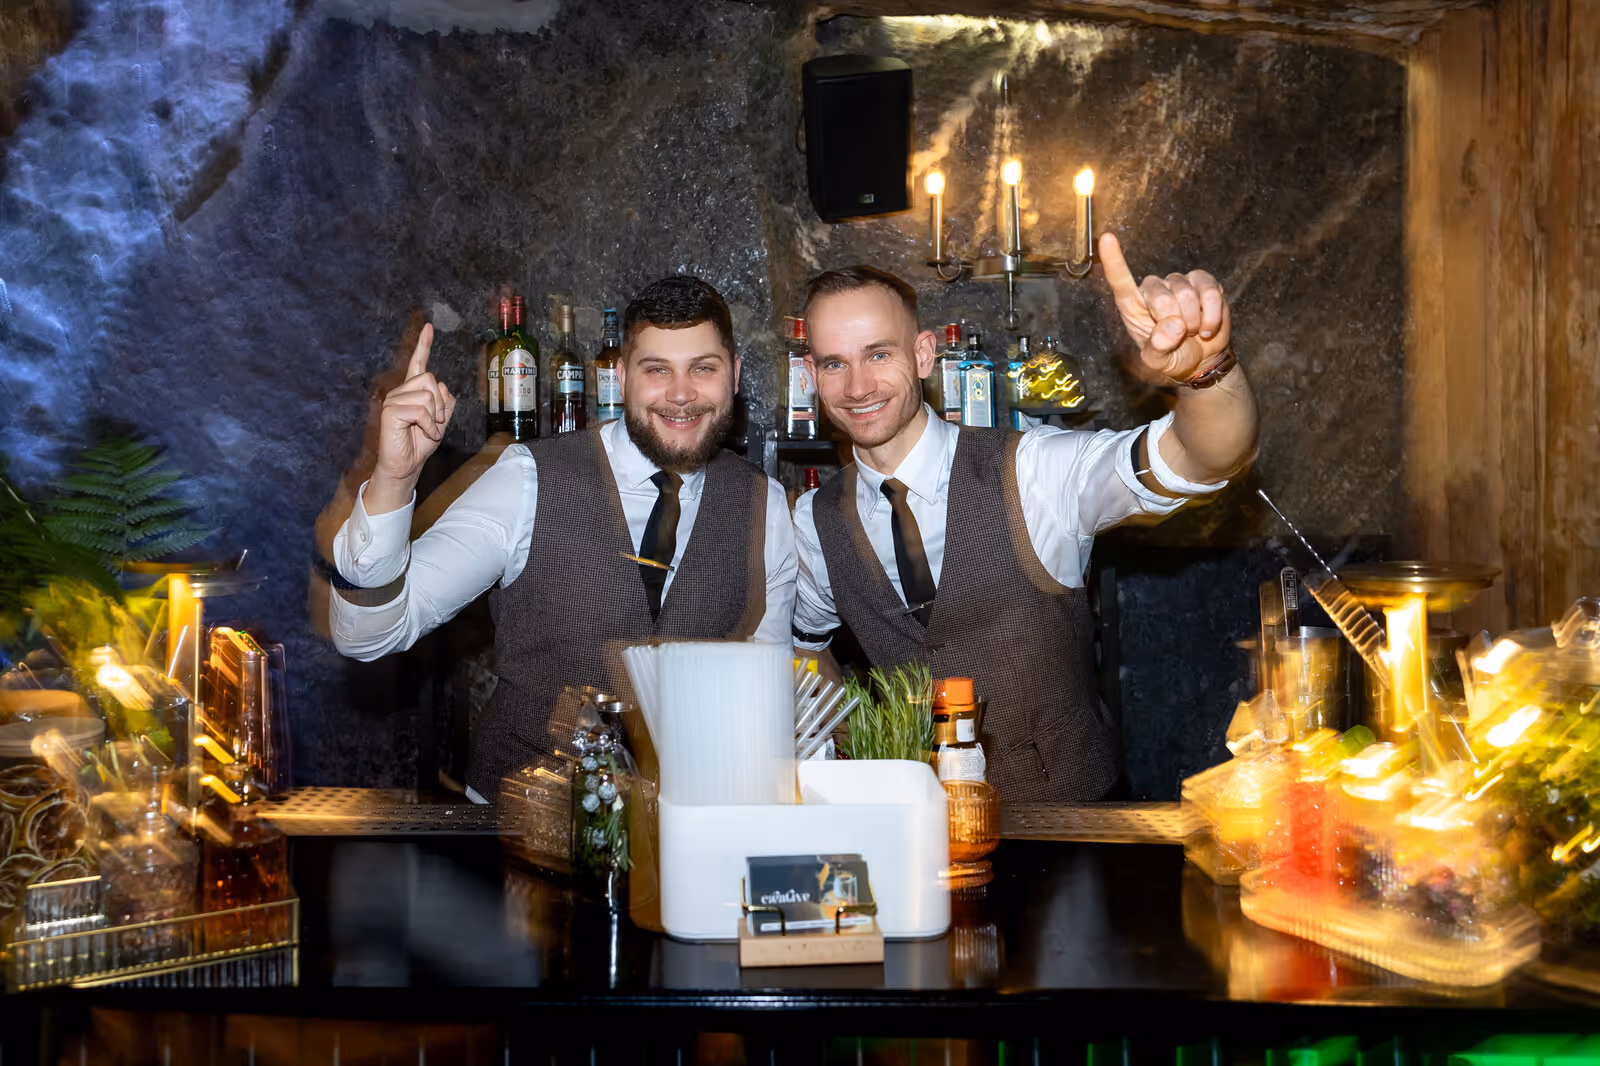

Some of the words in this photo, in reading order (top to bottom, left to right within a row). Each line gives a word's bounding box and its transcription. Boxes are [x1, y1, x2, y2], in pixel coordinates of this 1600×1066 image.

[504, 367, 535, 376] MARTINI
[509, 387, 531, 395] RSSO
[760, 889, 811, 905] creative
